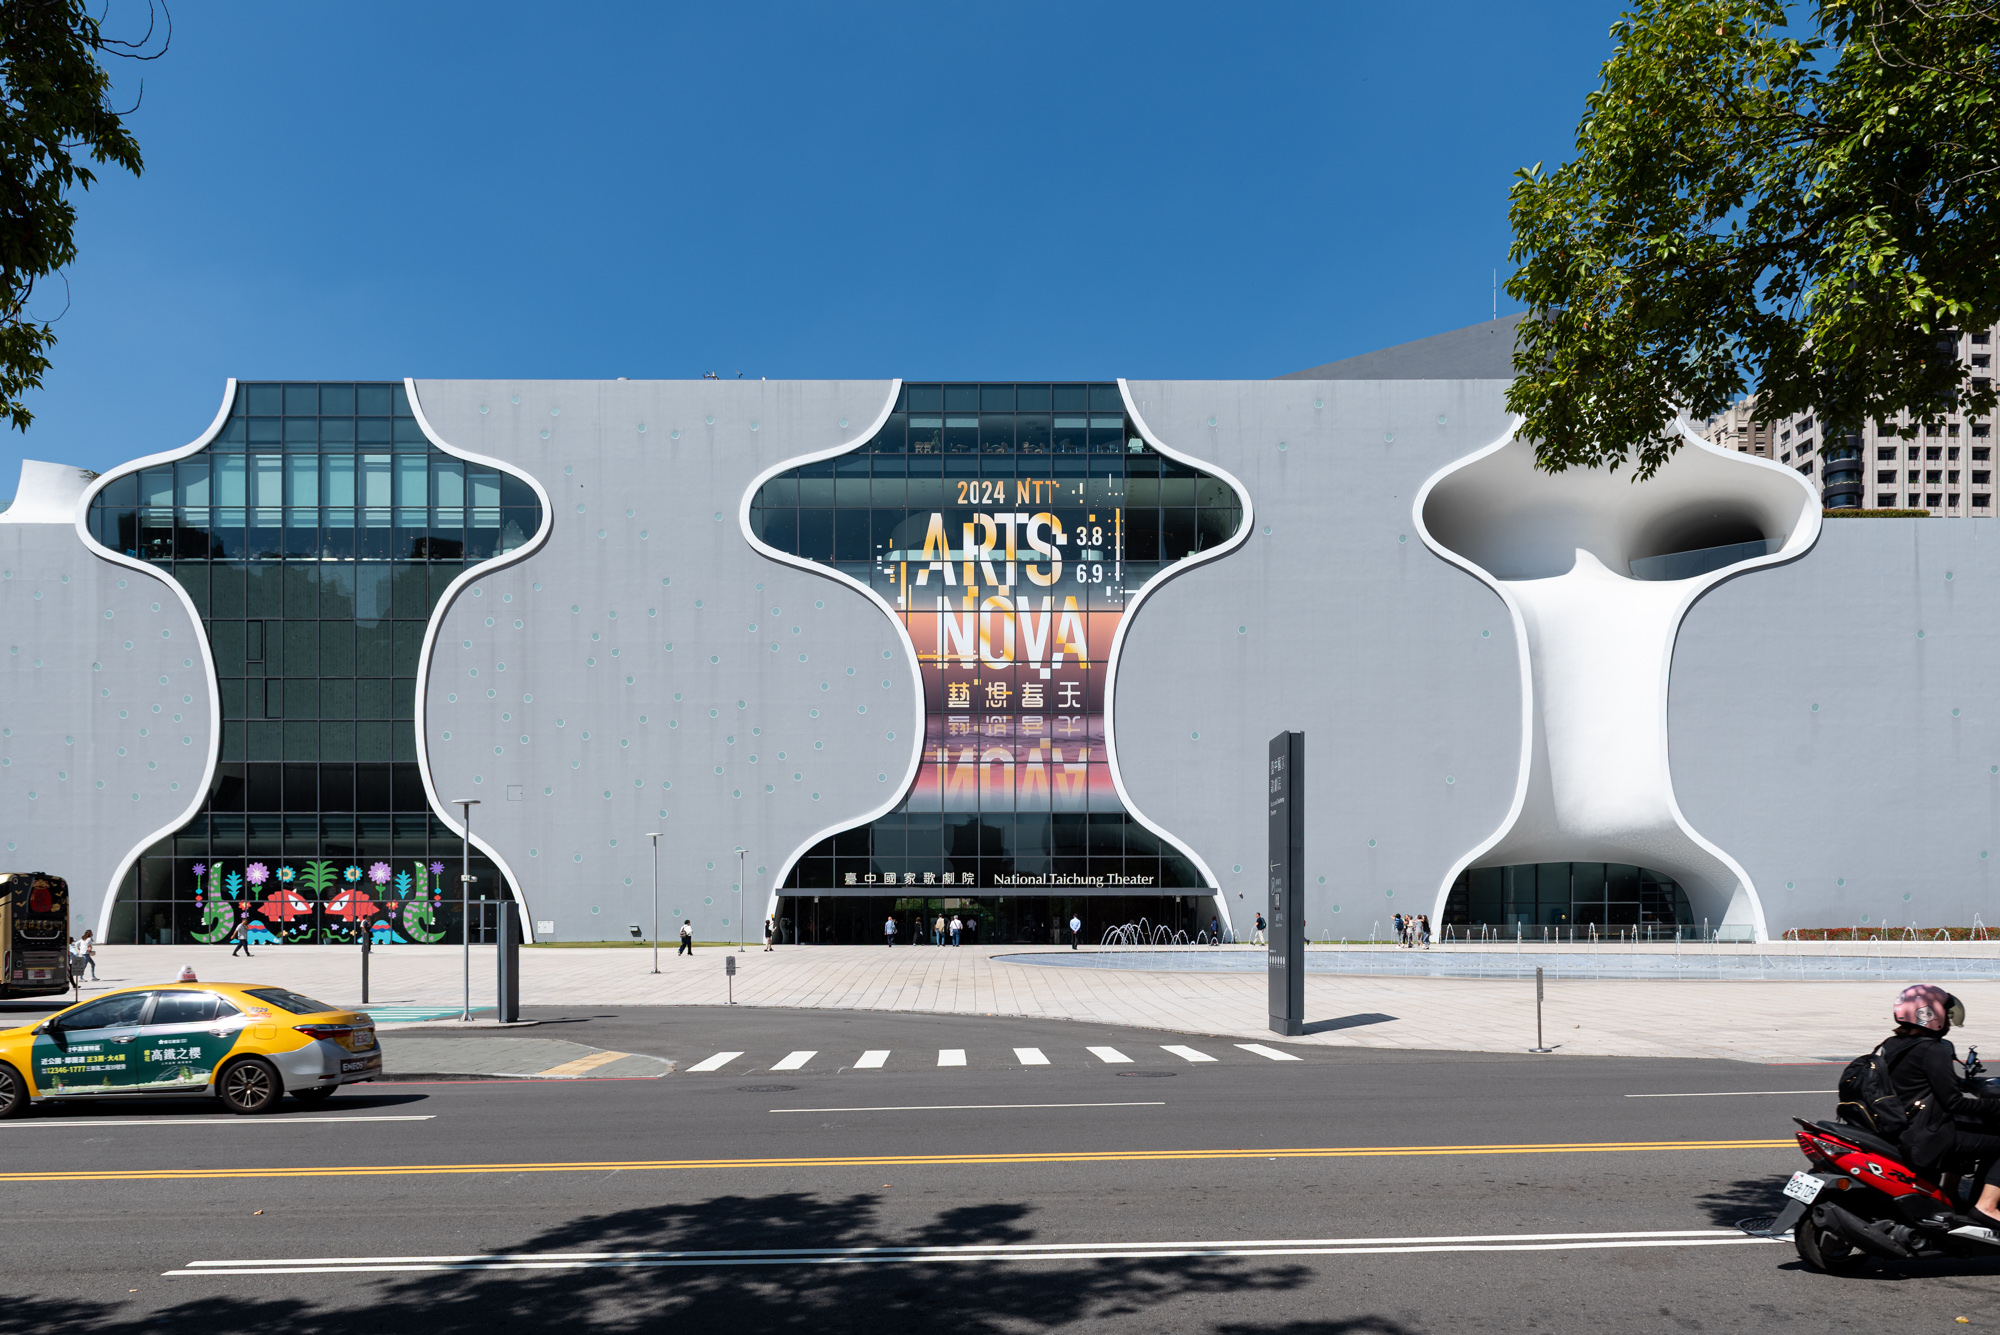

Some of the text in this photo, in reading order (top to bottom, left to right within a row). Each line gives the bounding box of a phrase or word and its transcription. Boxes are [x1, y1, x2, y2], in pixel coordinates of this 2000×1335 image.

[957, 481, 1006, 505] 2024
[1076, 526, 1103, 546] 3.8
[915, 512, 1068, 586] ARTS
[1076, 564, 1103, 584] 6.9
[936, 595, 1092, 671] NOVA
[844, 871, 975, 886] 臺中國家歌劇院
[994, 872, 1155, 889] National Taichung Theater
[342, 1061, 364, 1072] ENEOS
